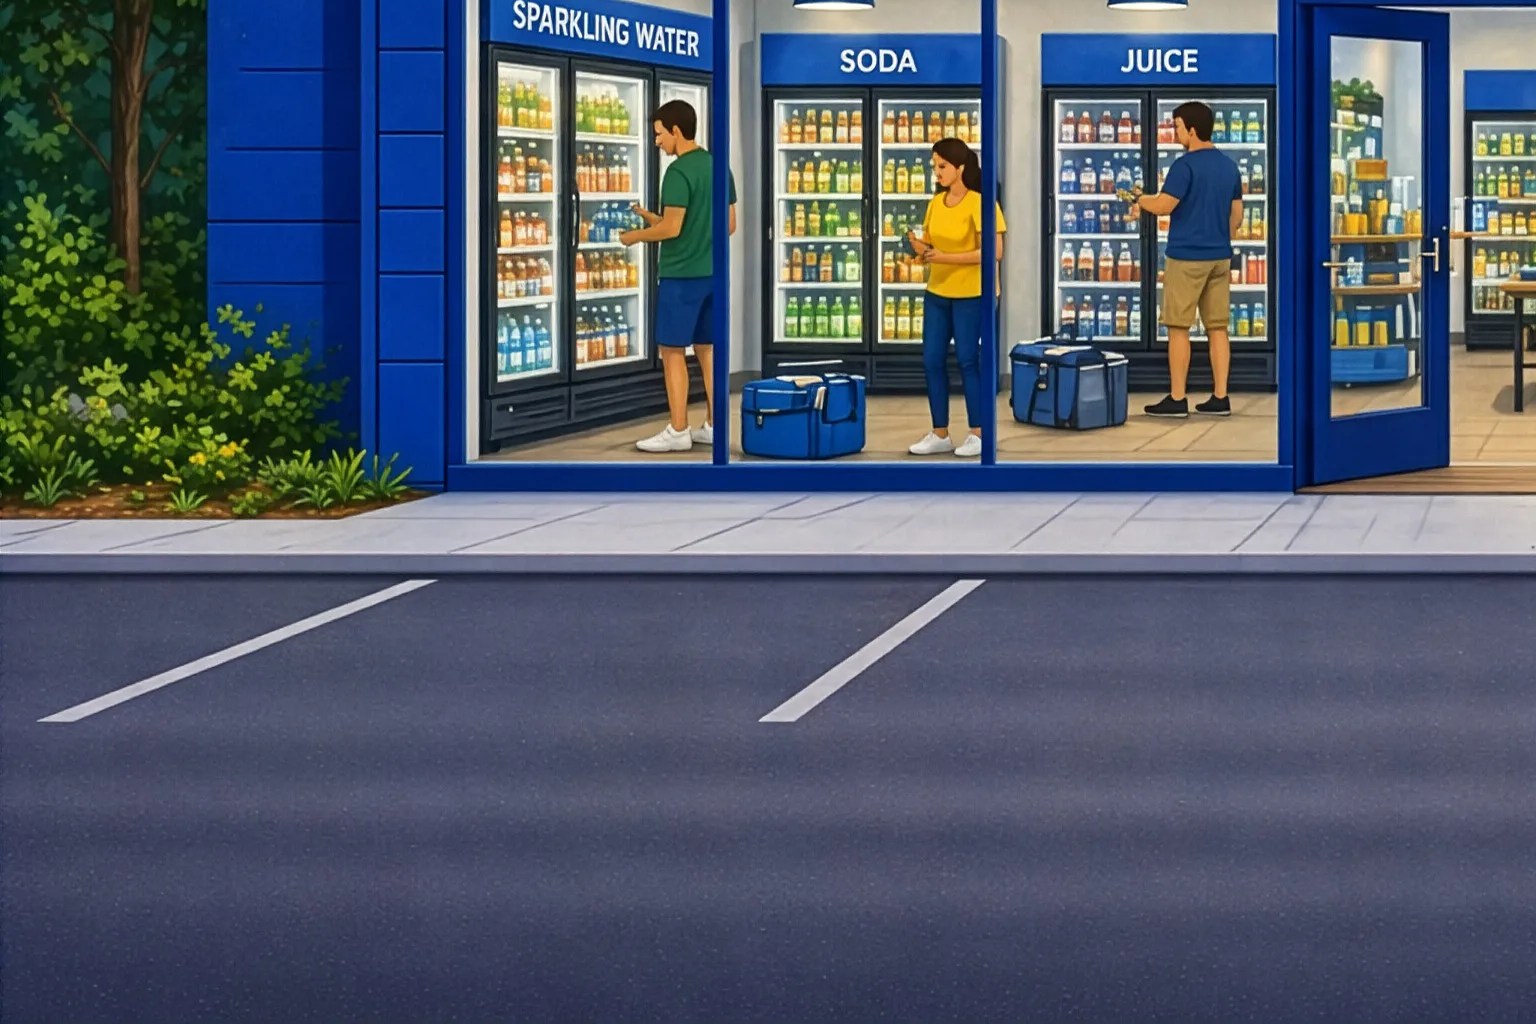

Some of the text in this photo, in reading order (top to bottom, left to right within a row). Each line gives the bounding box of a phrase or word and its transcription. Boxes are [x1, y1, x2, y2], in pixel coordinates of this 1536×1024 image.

[513, 0, 700, 57] SPARKLING WATER
[840, 48, 917, 73] SODA
[1120, 48, 1199, 73] JUICE
